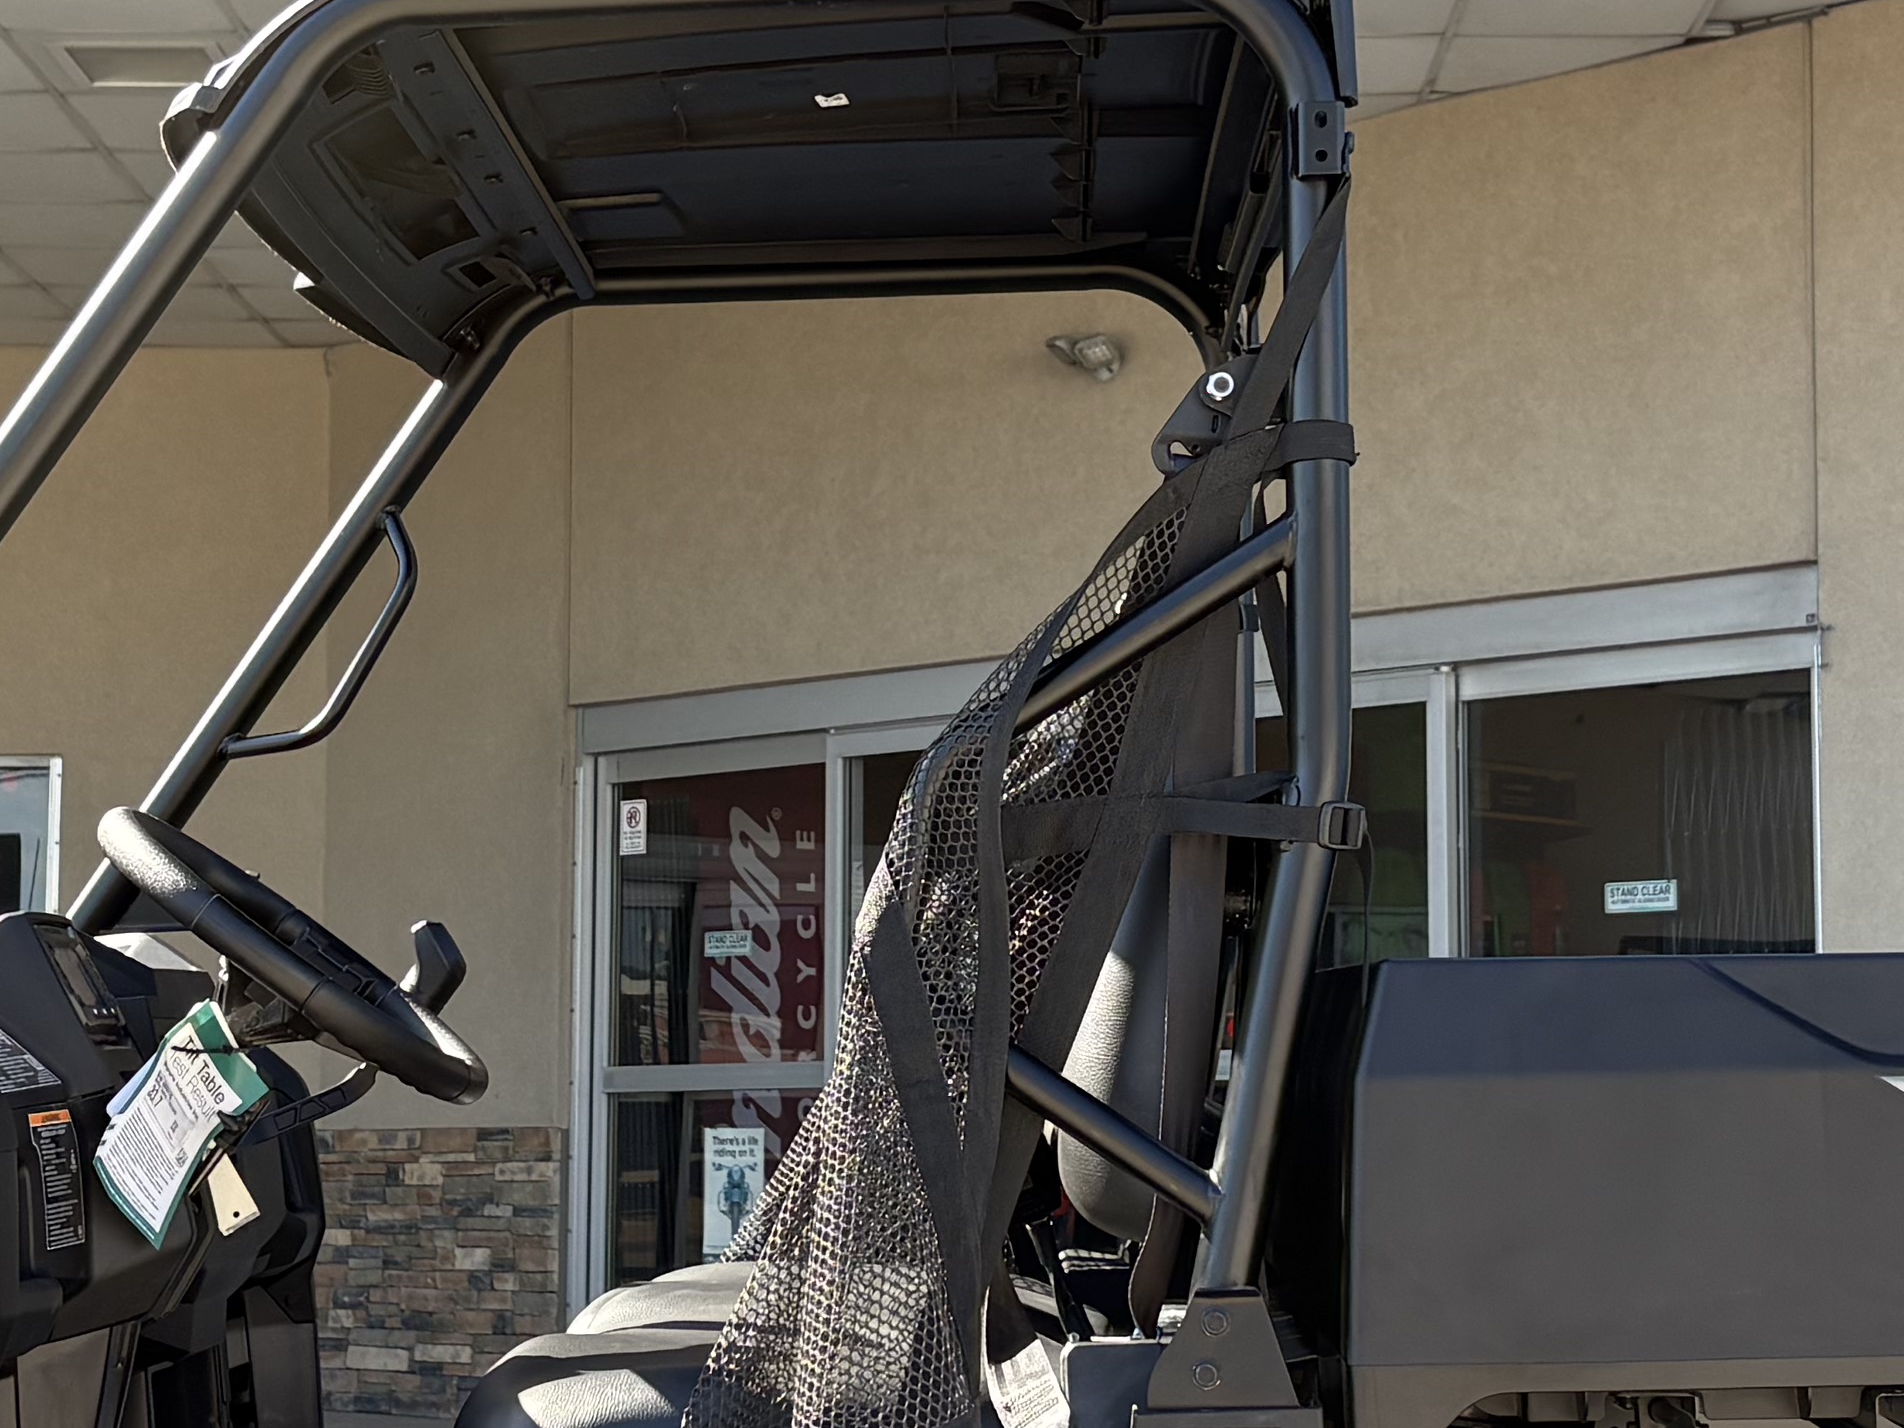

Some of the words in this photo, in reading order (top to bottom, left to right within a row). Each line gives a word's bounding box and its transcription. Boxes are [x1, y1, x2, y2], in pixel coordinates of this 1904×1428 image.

[1610, 887, 1639, 899] STAND
[1641, 884, 1671, 897] CLEAR
[197, 1060, 226, 1105] Table
